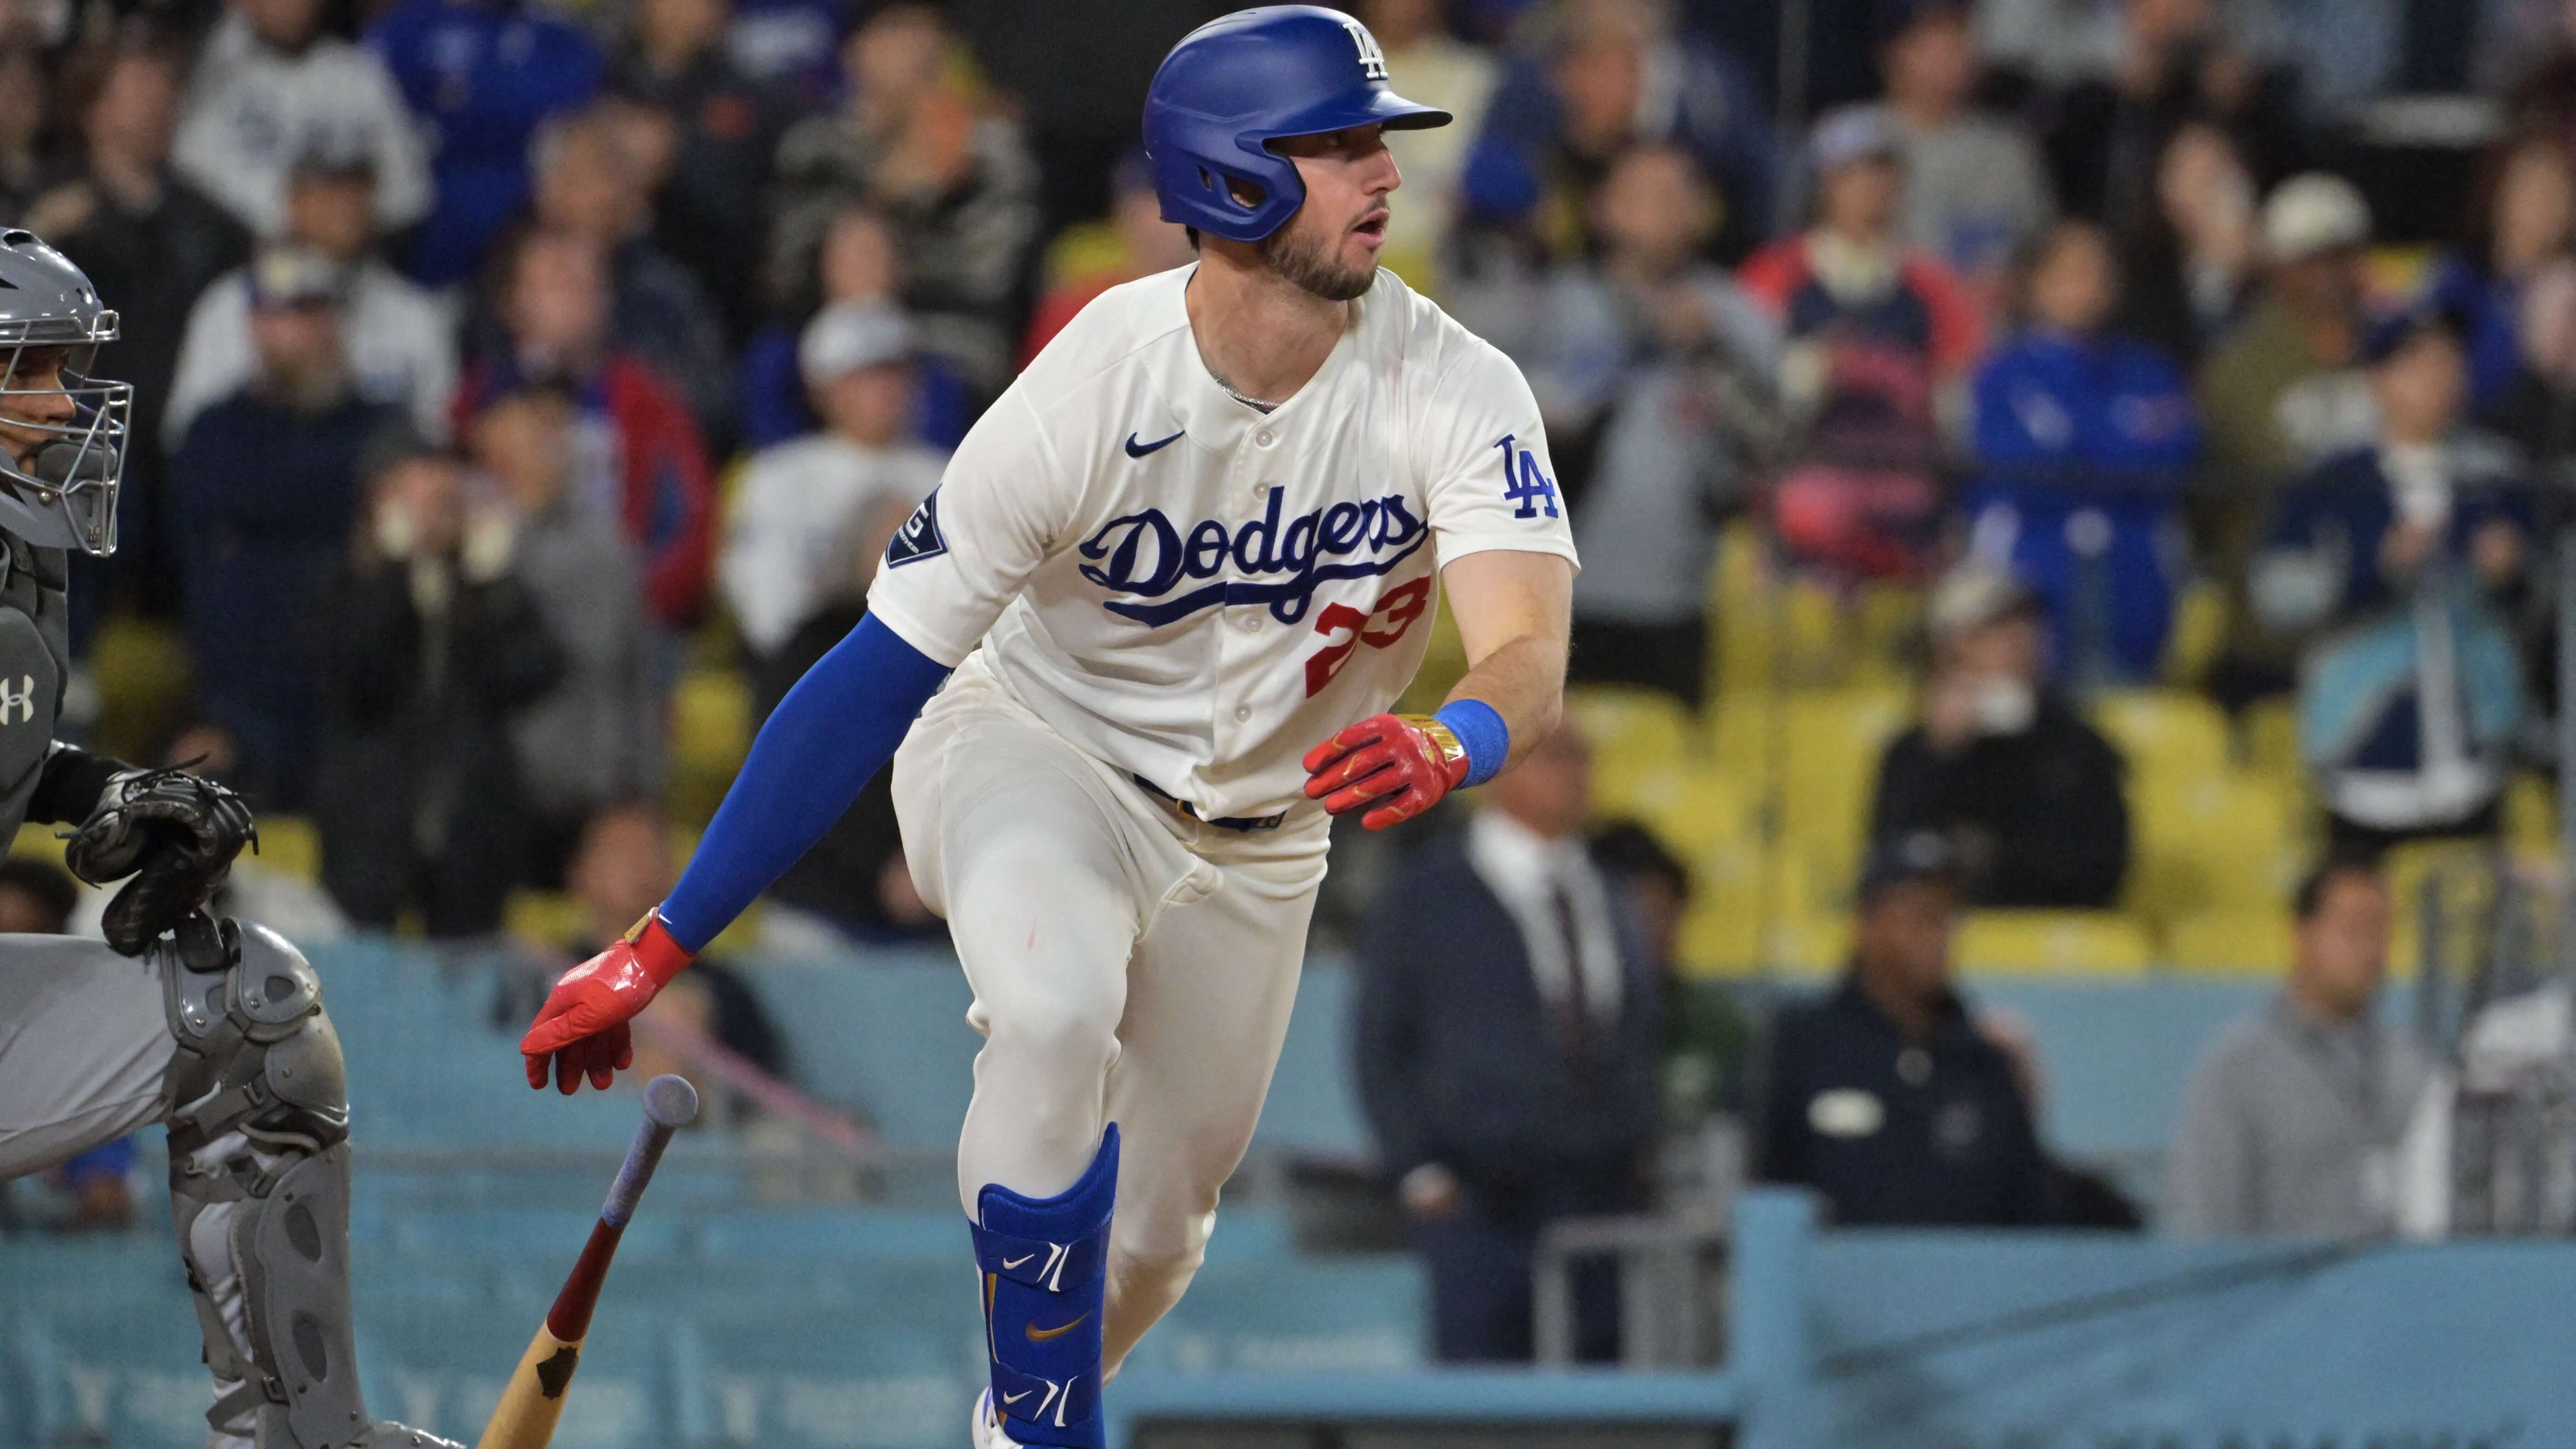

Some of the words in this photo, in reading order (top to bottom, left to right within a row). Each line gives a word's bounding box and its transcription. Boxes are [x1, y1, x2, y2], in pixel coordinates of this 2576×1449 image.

[1342, 22, 1388, 79] LA
[1493, 434, 1558, 518] LA
[1079, 486, 1429, 627] Dodgers
[1305, 575, 1431, 699] 23
